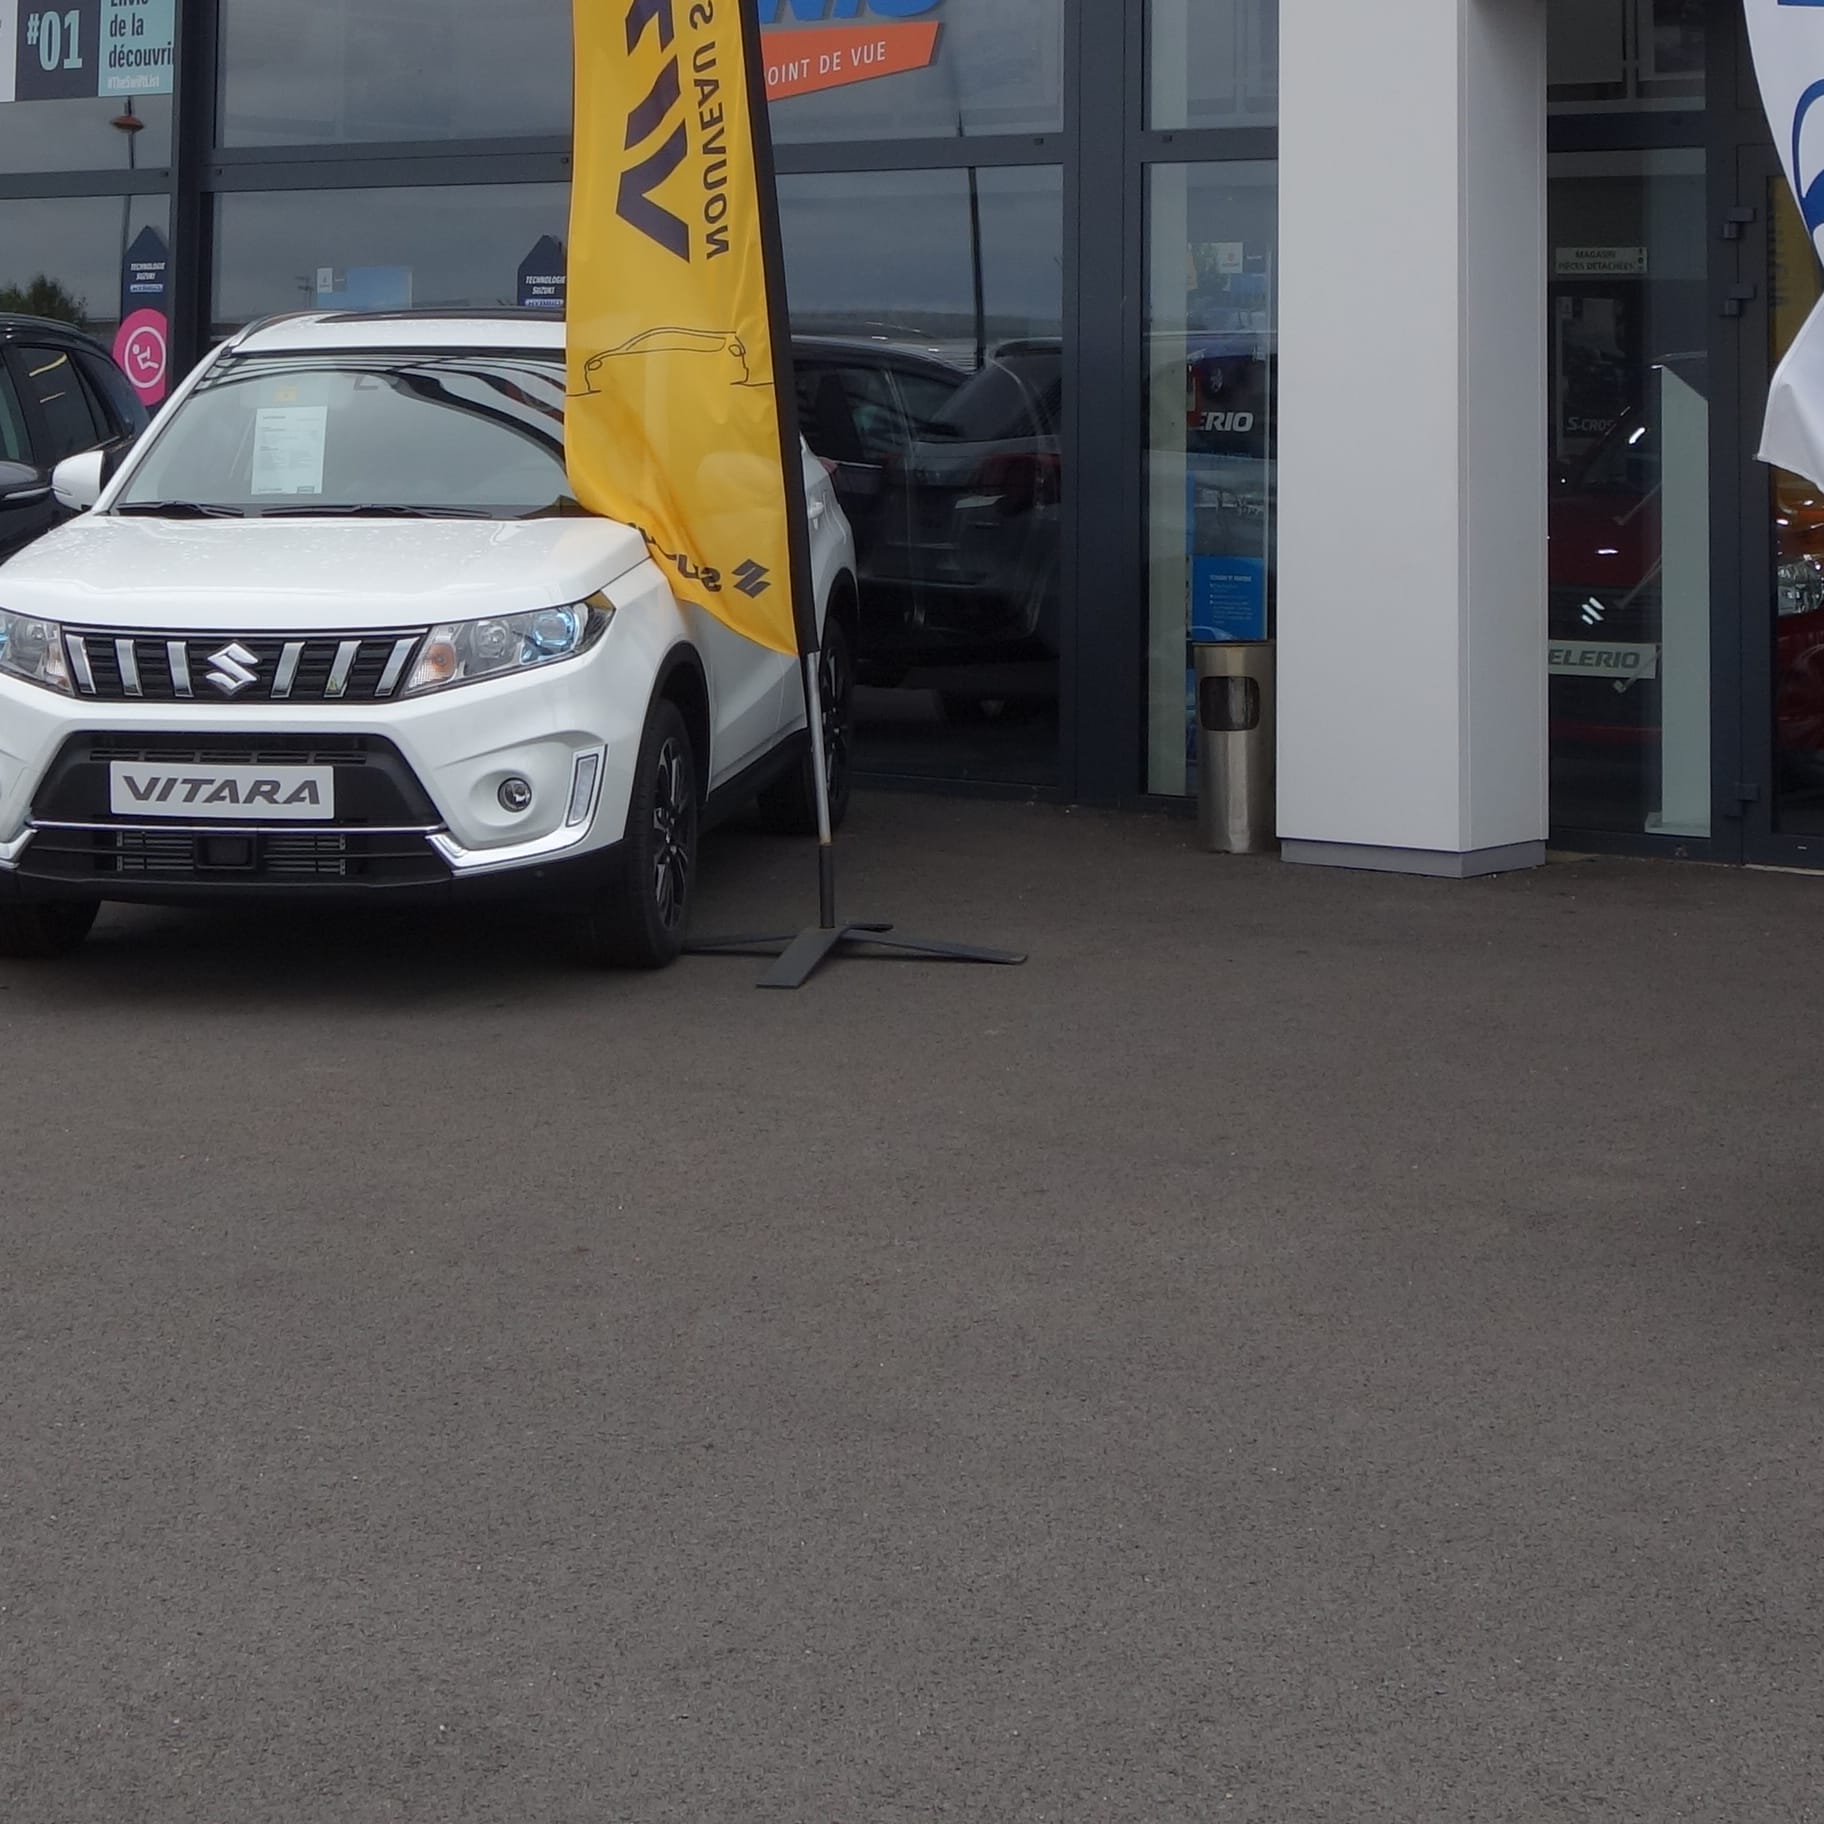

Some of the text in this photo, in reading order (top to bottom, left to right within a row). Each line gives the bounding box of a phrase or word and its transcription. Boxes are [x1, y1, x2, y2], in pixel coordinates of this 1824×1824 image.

[27, 9, 83, 71] #01
[109, 13, 144, 38] de la
[108, 41, 173, 69] découvri
[767, 41, 887, 86] OINT DE VUE
[1549, 649, 1641, 669] ELERIO
[122, 775, 320, 805] VITARA
